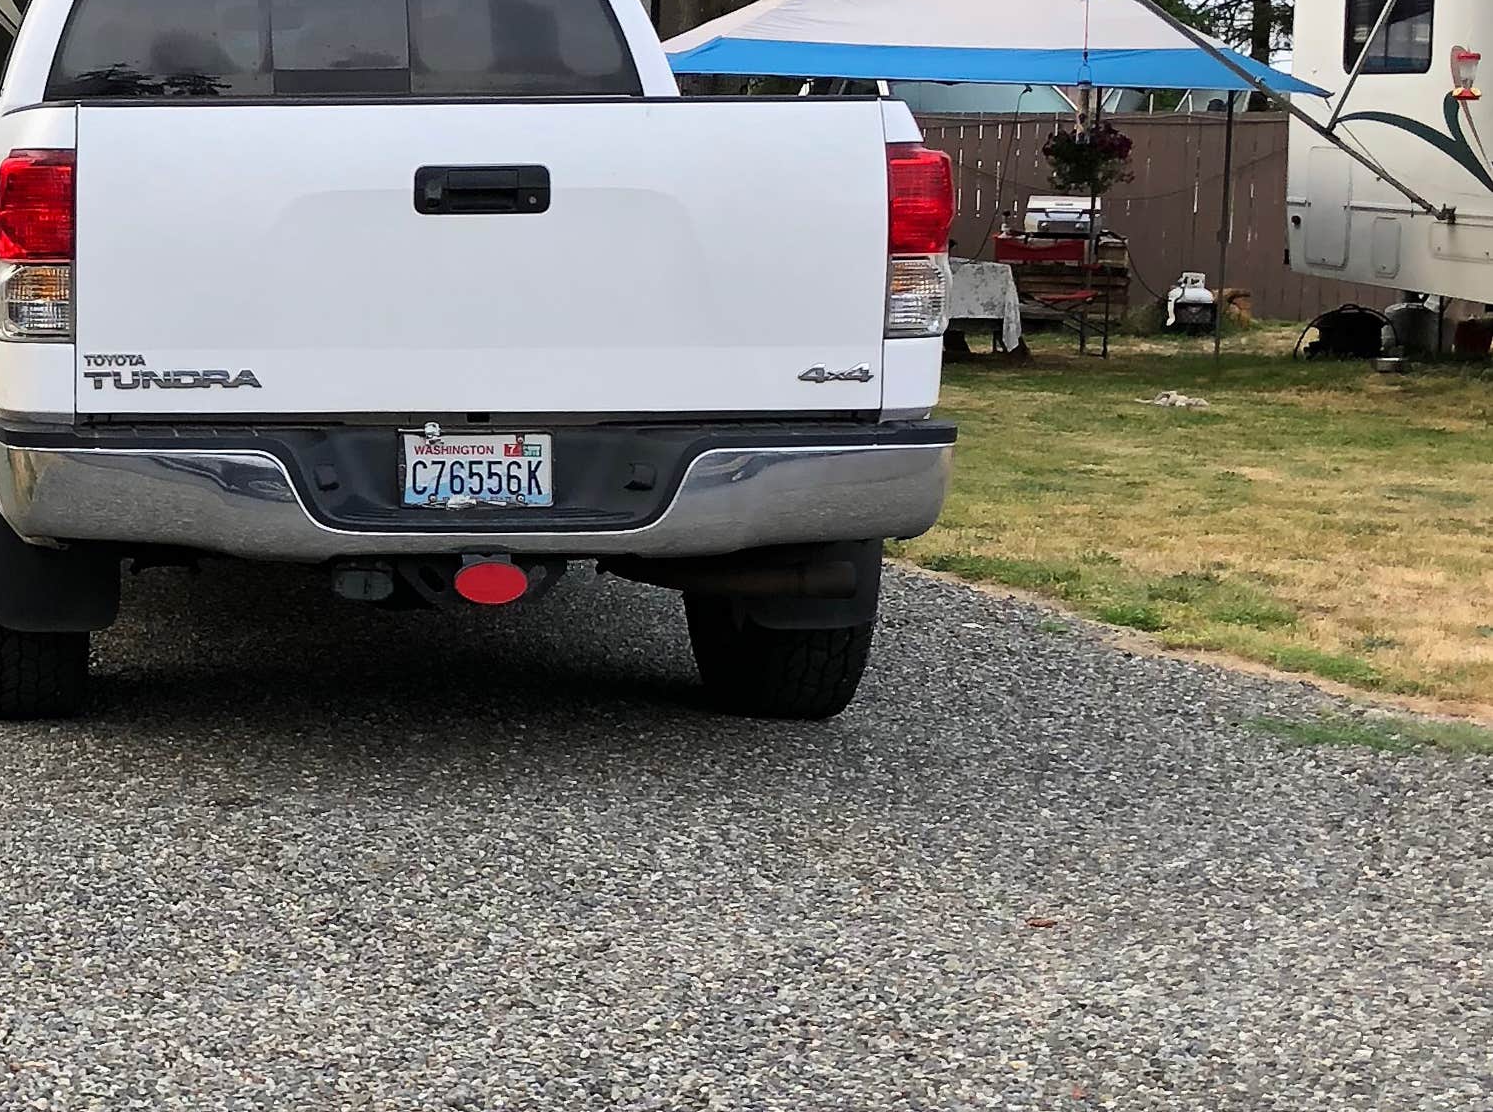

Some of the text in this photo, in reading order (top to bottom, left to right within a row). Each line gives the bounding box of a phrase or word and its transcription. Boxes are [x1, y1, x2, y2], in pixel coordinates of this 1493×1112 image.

[83, 354, 146, 367] TOYOTA
[83, 370, 263, 390] TUNDRA
[414, 445, 494, 455] WASHINGTON
[412, 460, 543, 496] C76556K
